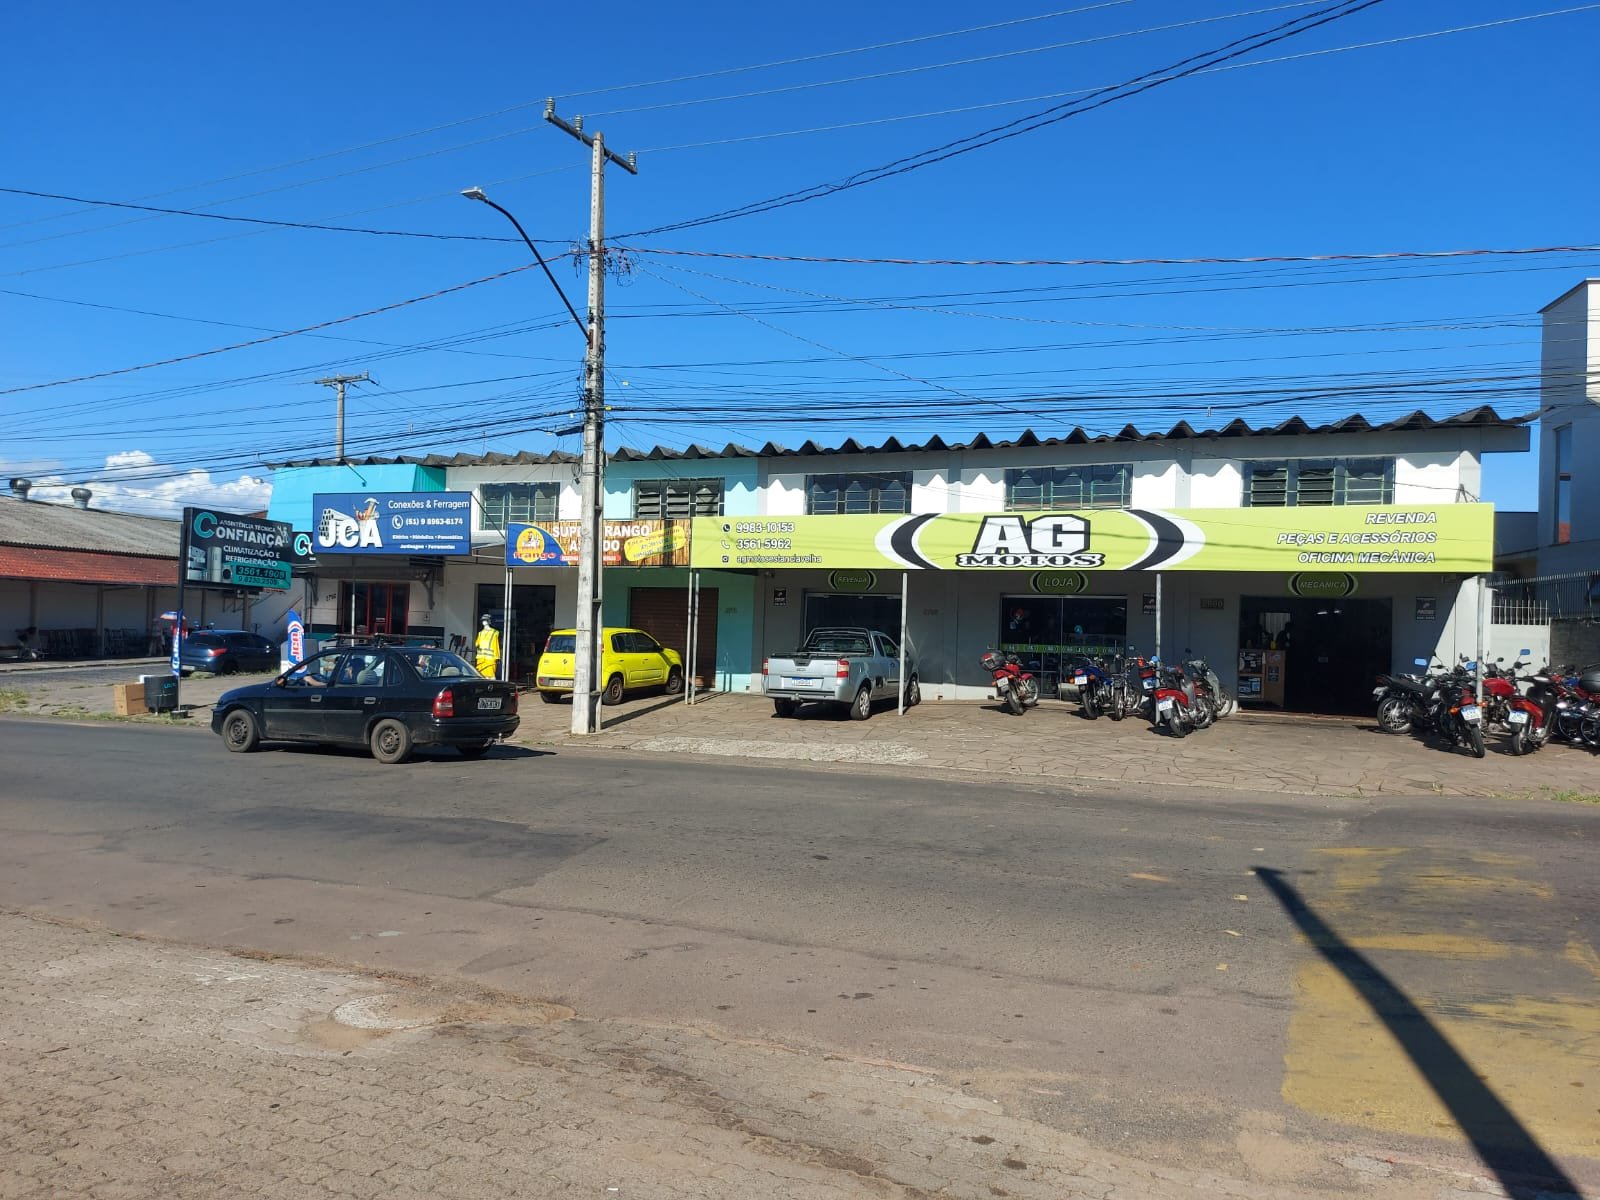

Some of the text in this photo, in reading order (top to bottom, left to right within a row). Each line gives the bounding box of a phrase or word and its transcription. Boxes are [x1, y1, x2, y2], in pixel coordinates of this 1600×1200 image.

[387, 499, 470, 511] Conexões & Ferragem
[1365, 511, 1437, 525] REVENDA
[193, 511, 283, 548] CONFIANÇA
[318, 516, 383, 548] JCA
[552, 526, 580, 537] SUP
[604, 525, 650, 537] RANGO
[736, 521, 795, 533] 9983-10153
[971, 514, 1091, 555] AG
[1277, 529, 1437, 547] PEÇAS E ACESSÓRIOS
[223, 544, 274, 558] CLIMATIZAÇÃO
[736, 538, 792, 550] 3561-5962
[224, 554, 278, 567] REFRIGERAÇÃO
[955, 552, 1106, 568] MOTOS
[1297, 549, 1436, 564] OFICINA MECÂNICA
[1044, 577, 1074, 587] LOJA
